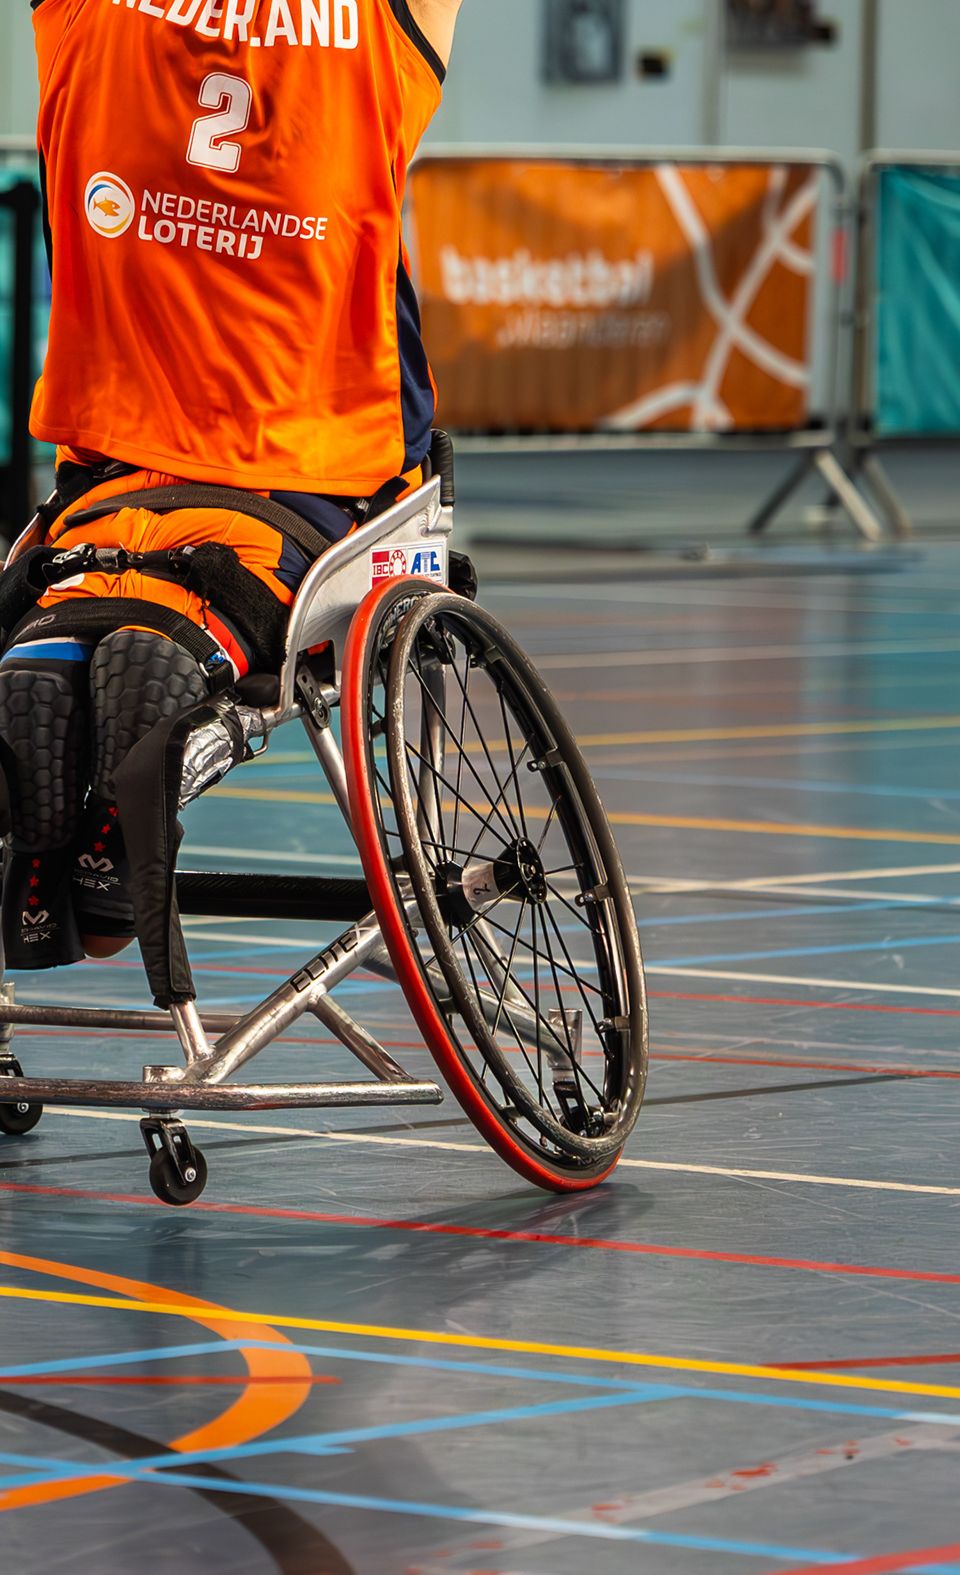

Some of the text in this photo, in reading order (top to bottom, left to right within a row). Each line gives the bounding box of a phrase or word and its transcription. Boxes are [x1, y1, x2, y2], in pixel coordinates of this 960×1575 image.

[185, 71, 253, 173] 2
[138, 215, 264, 260] LOTERIJ
[141, 189, 328, 241] NEDERLANDSE
[373, 564, 389, 576] IBC
[73, 875, 111, 892] HEX
[23, 931, 51, 944] HEX
[290, 932, 359, 993] ELITE
